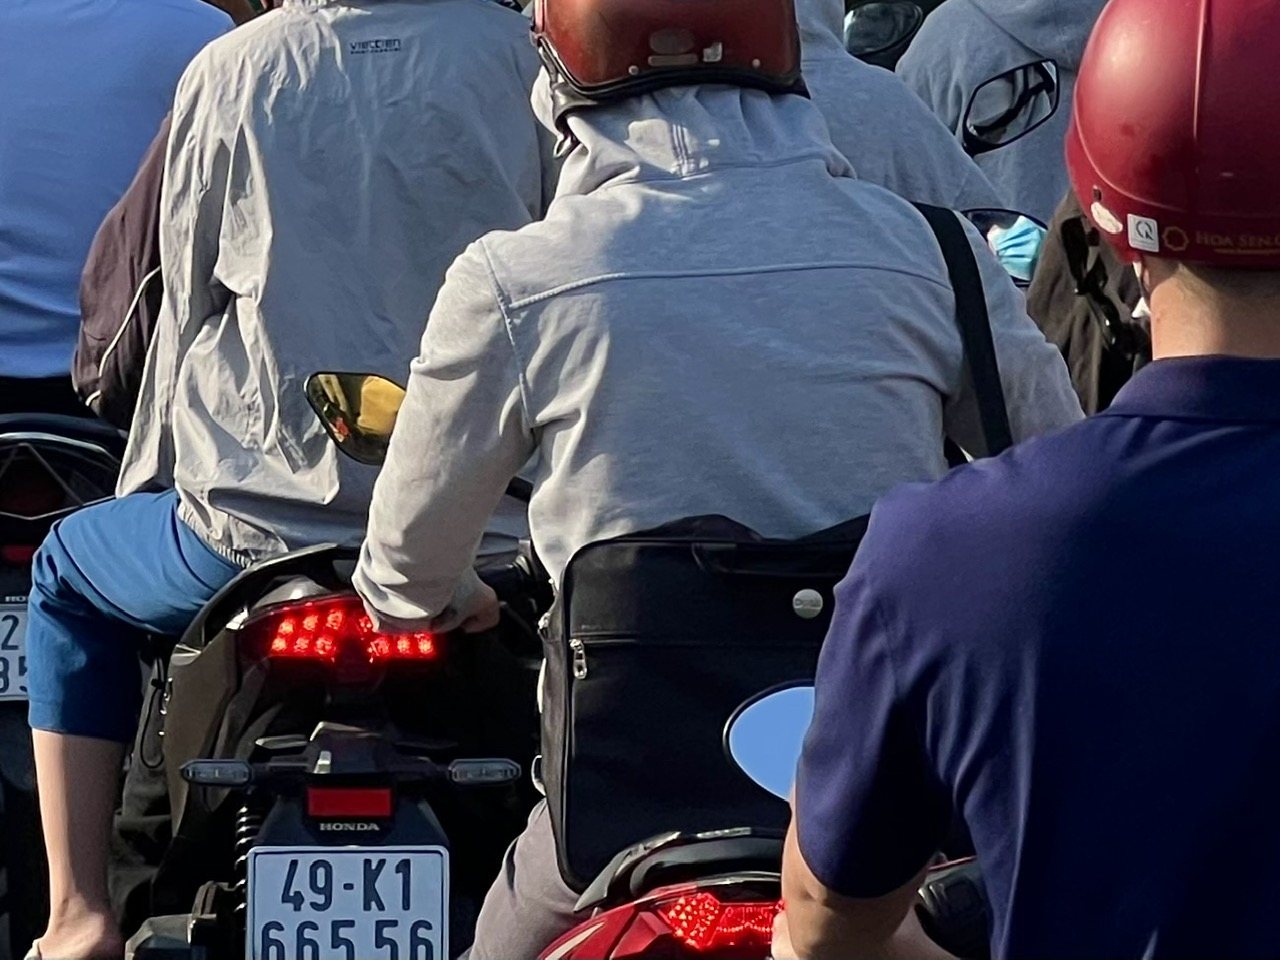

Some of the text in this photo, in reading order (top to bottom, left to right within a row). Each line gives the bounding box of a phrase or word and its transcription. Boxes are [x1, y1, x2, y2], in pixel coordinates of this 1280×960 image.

[1195, 230, 1234, 246] HOA
[319, 822, 380, 831] HONDA
[281, 858, 412, 912] 49-K1
